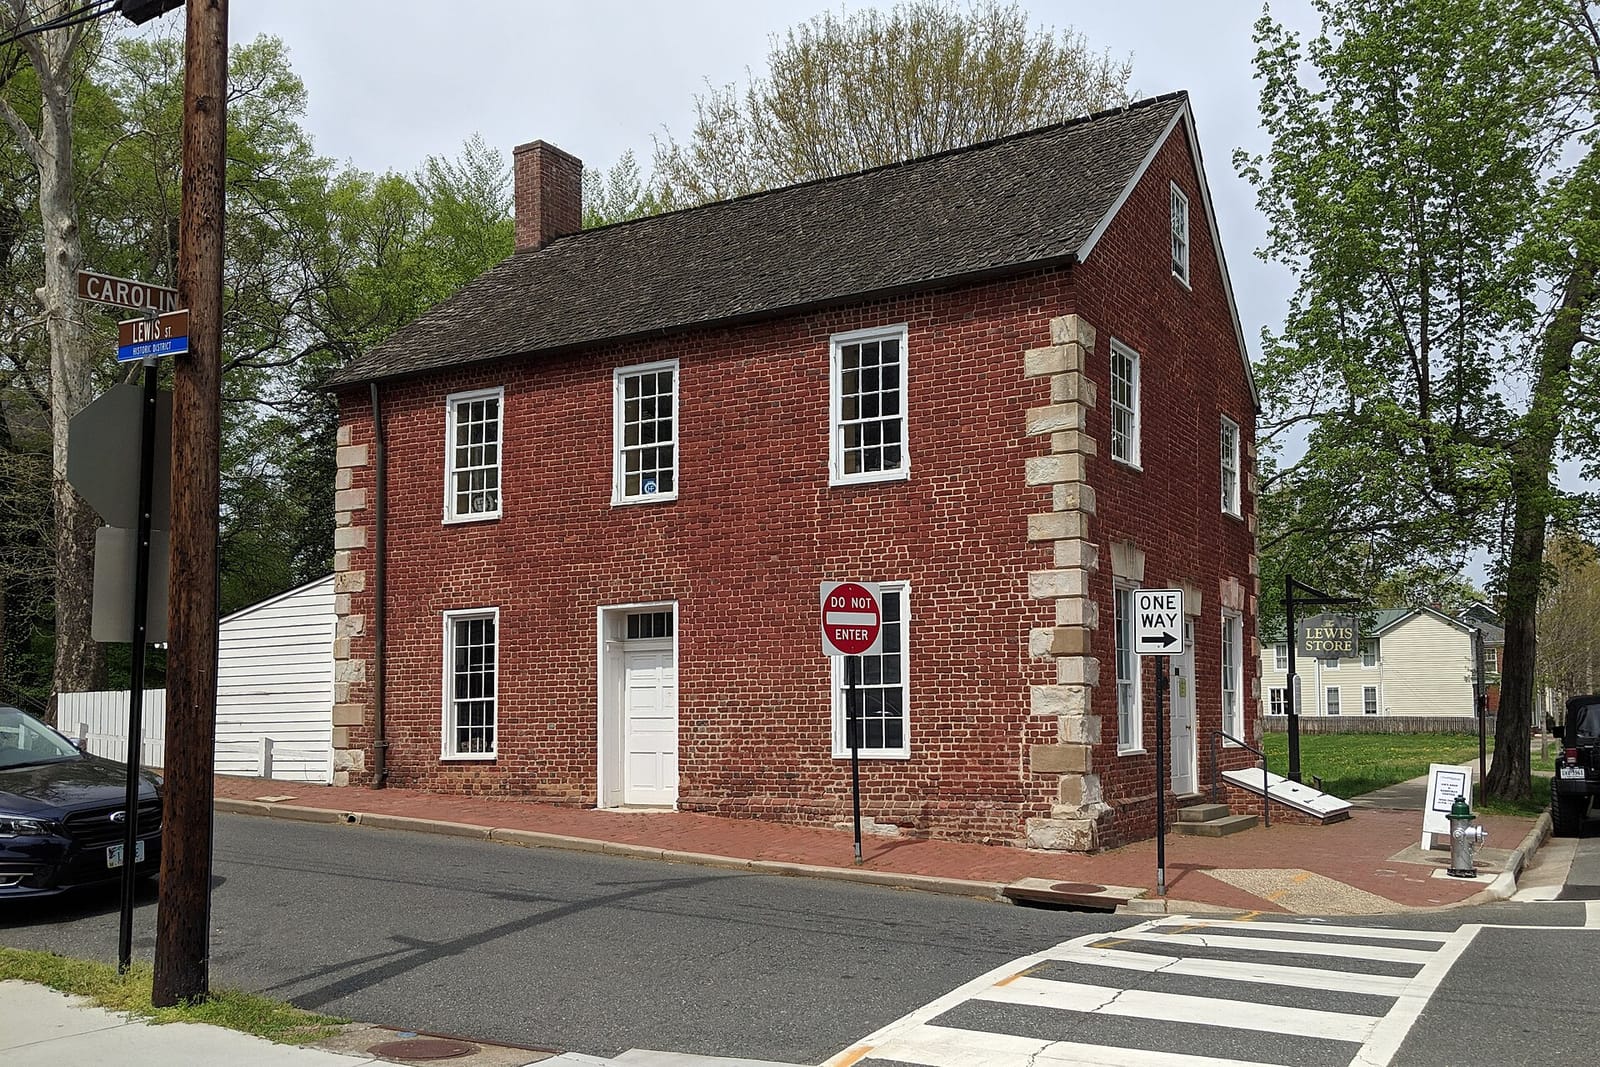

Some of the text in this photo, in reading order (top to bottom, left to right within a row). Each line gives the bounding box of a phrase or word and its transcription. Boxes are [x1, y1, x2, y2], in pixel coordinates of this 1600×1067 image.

[132, 320, 160, 343] LEWIS
[132, 341, 172, 356] HISTORIC DISTRICT
[831, 596, 871, 609] DO NOT
[1140, 595, 1176, 610] ONE
[1141, 613, 1177, 628] WAY
[835, 629, 868, 640] ENTER
[1305, 627, 1353, 639] LEWIS
[1305, 640, 1352, 651] STORE
